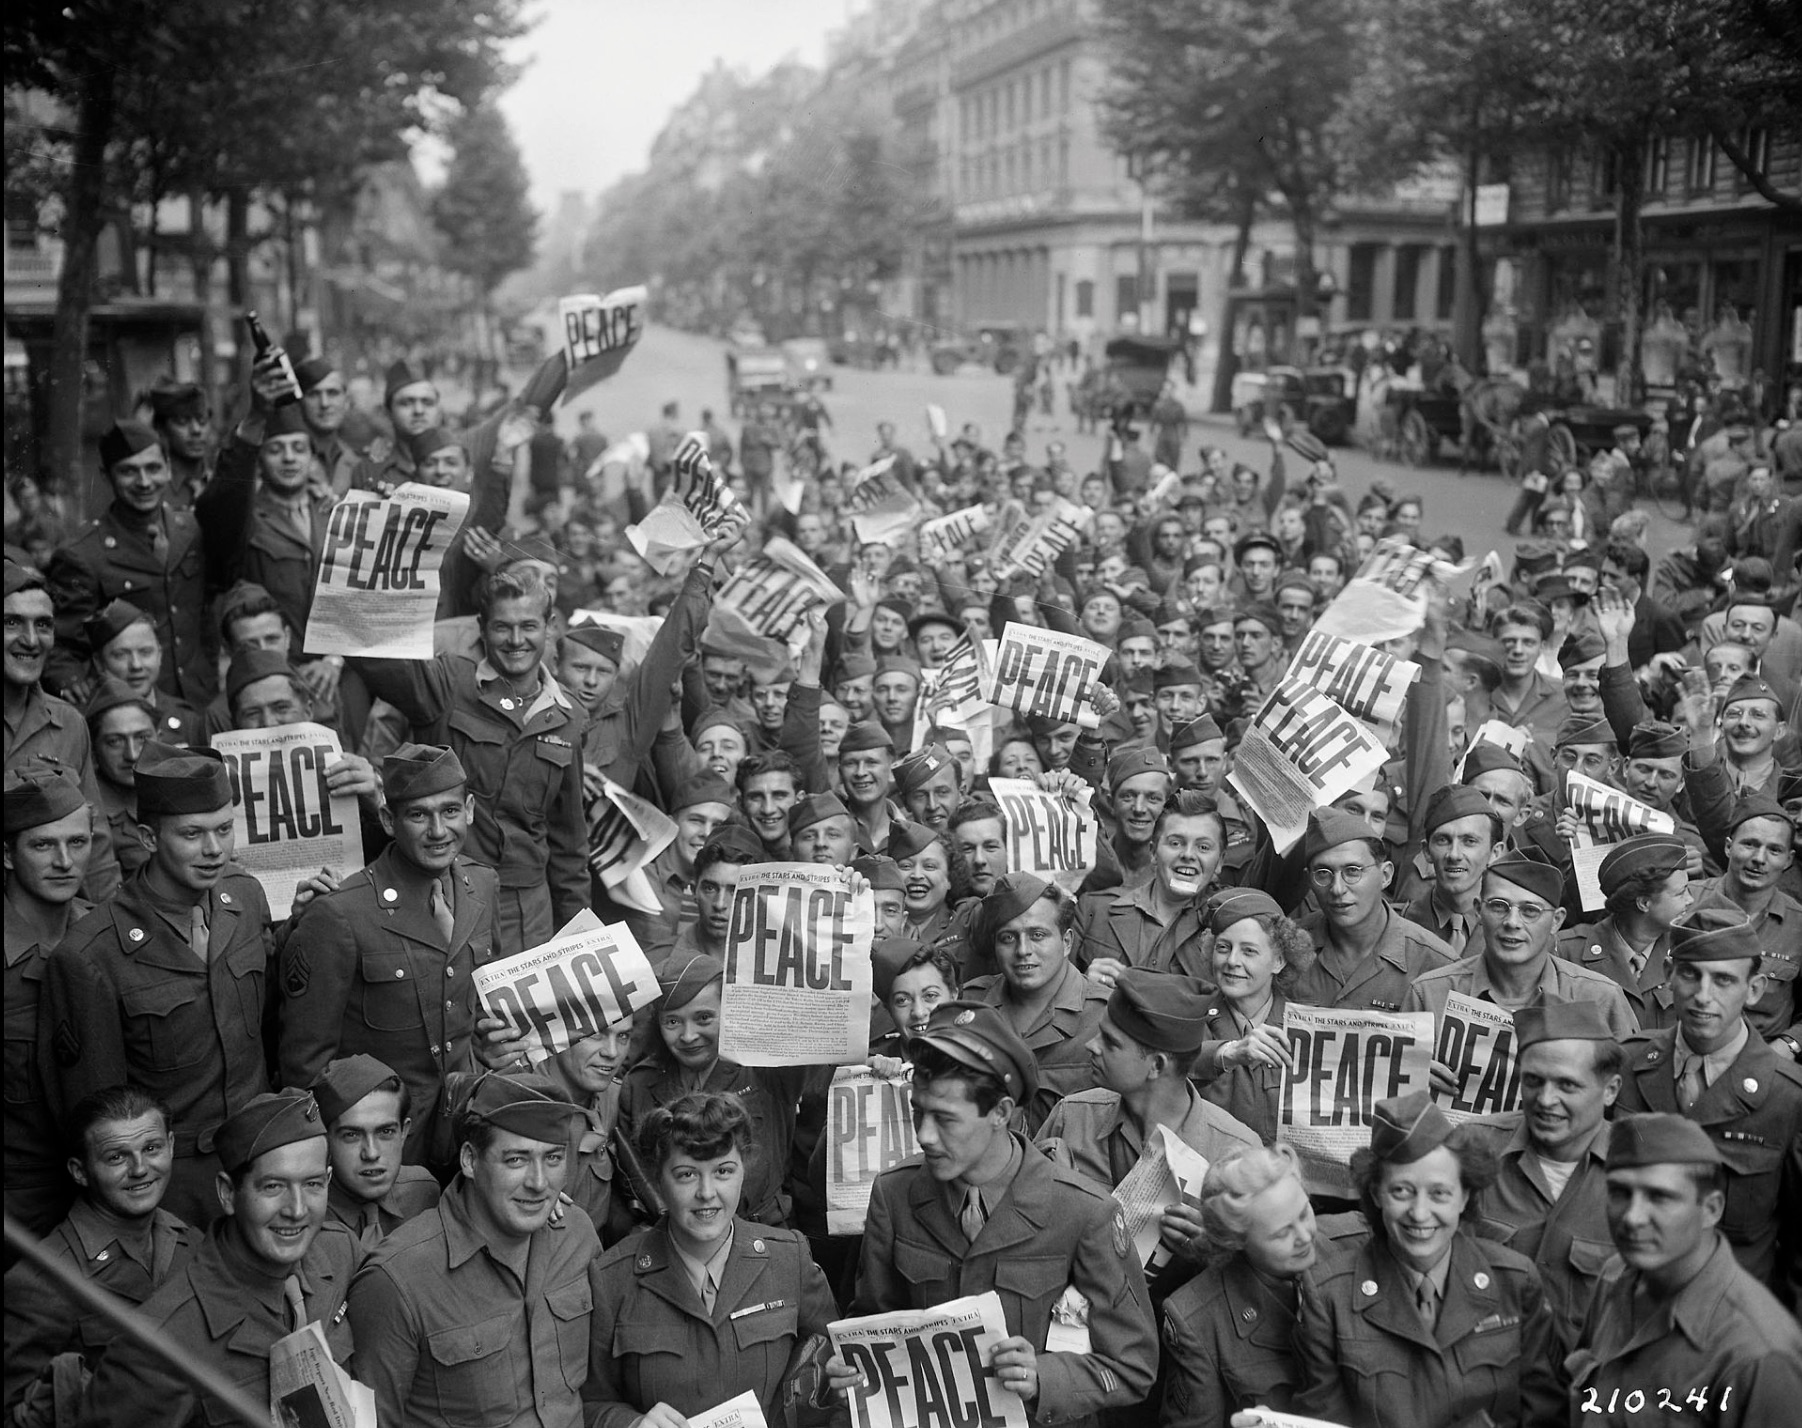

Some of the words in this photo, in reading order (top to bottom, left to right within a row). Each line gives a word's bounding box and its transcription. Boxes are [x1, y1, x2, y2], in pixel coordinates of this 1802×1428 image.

[565, 304, 637, 369] PEACE
[321, 501, 449, 590] PEACE
[991, 640, 1098, 725] PEACE
[1291, 631, 1396, 725] PEACE
[1254, 676, 1372, 790] PEACE
[1001, 795, 1087, 871] PEACE
[772, 872, 790, 880] STARS
[791, 873, 806, 881] AND
[806, 874, 830, 883] STRIPES
[480, 971, 506, 986] EXTRA
[507, 965, 520, 976] THE
[520, 957, 542, 971] STARS
[542, 951, 557, 963] AND
[558, 942, 584, 956] STRIPES
[726, 885, 853, 990] PEACE
[485, 944, 637, 1056] PEACE
[1314, 1016, 1325, 1024] THE
[1326, 1018, 1346, 1027] STARS
[1348, 1019, 1362, 1027] AND
[1363, 1020, 1388, 1029] STRIPES
[1471, 1008, 1481, 1018] THE
[1483, 1011, 1502, 1023] STARS
[1282, 1027, 1415, 1126] PEACE
[880, 1327, 902, 1336] STARS
[903, 1327, 919, 1336] AND
[840, 1325, 1006, 1428] PEACE
